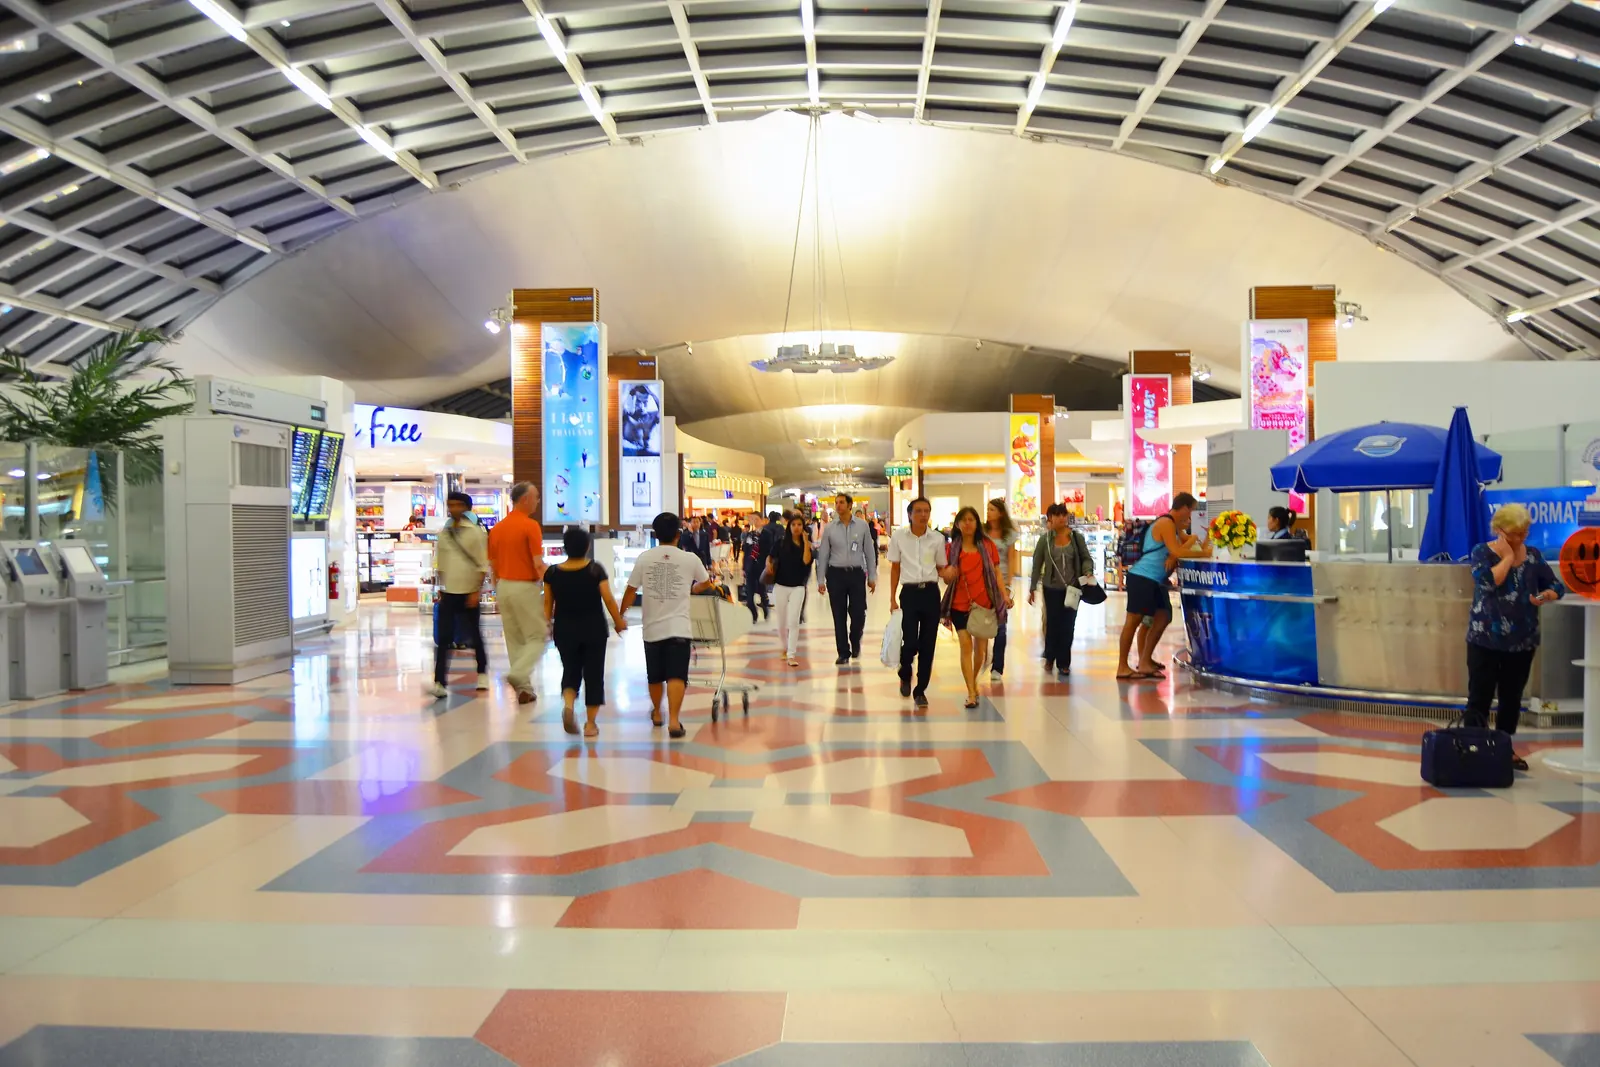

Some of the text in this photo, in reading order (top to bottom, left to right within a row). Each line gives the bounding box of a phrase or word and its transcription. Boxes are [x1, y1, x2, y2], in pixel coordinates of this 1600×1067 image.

[1143, 389, 1156, 429] ower
[370, 406, 422, 448] Free
[551, 428, 593, 437] THAILAND
[1523, 500, 1585, 525] ORMAT
